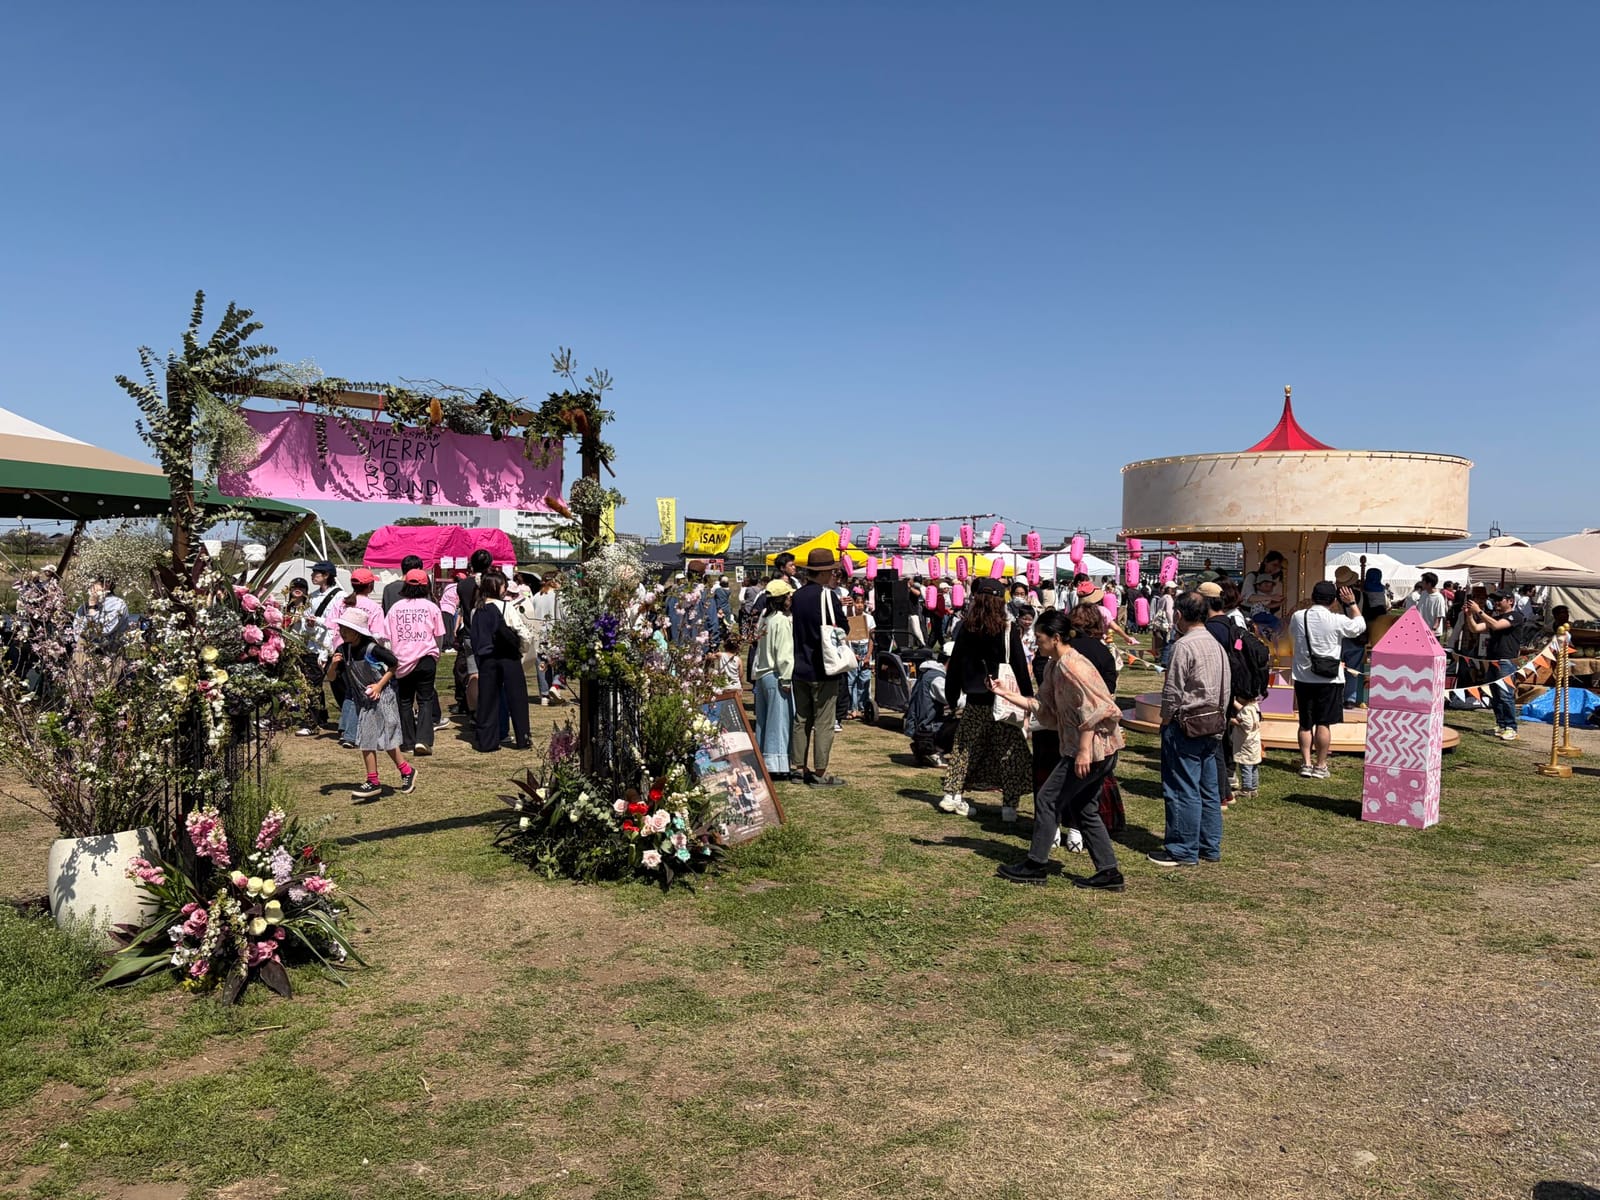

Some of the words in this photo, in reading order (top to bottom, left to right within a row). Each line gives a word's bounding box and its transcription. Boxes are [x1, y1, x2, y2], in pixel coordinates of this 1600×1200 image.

[368, 438, 440, 463] MERRY
[364, 458, 398, 476] GO
[365, 474, 439, 497] ROUND
[396, 613, 429, 624] MERRY
[396, 623, 412, 631] GO
[397, 630, 428, 639] ROUND
